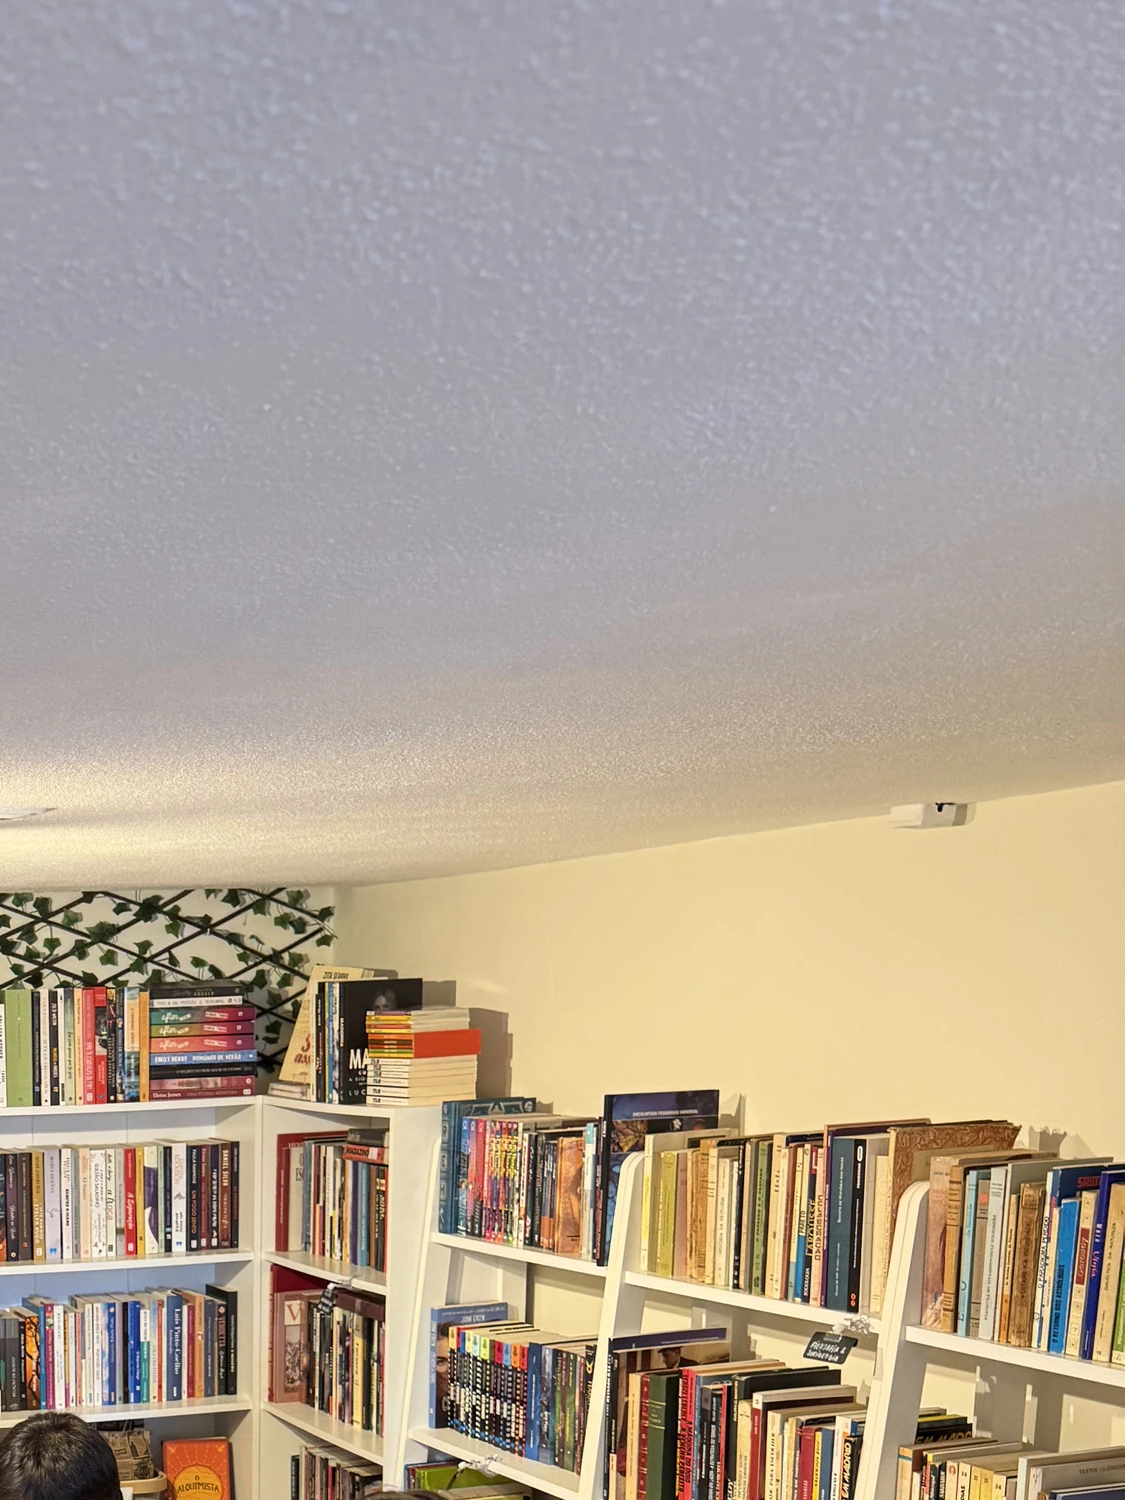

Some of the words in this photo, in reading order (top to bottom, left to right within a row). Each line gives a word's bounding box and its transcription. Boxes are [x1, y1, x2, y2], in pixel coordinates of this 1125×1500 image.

[1052, 1312, 1060, 1338] RETORNO
[842, 1442, 852, 1482] MADRID
[177, 1482, 219, 1493] ALQUIMISTA
[841, 1482, 849, 1499] EM
